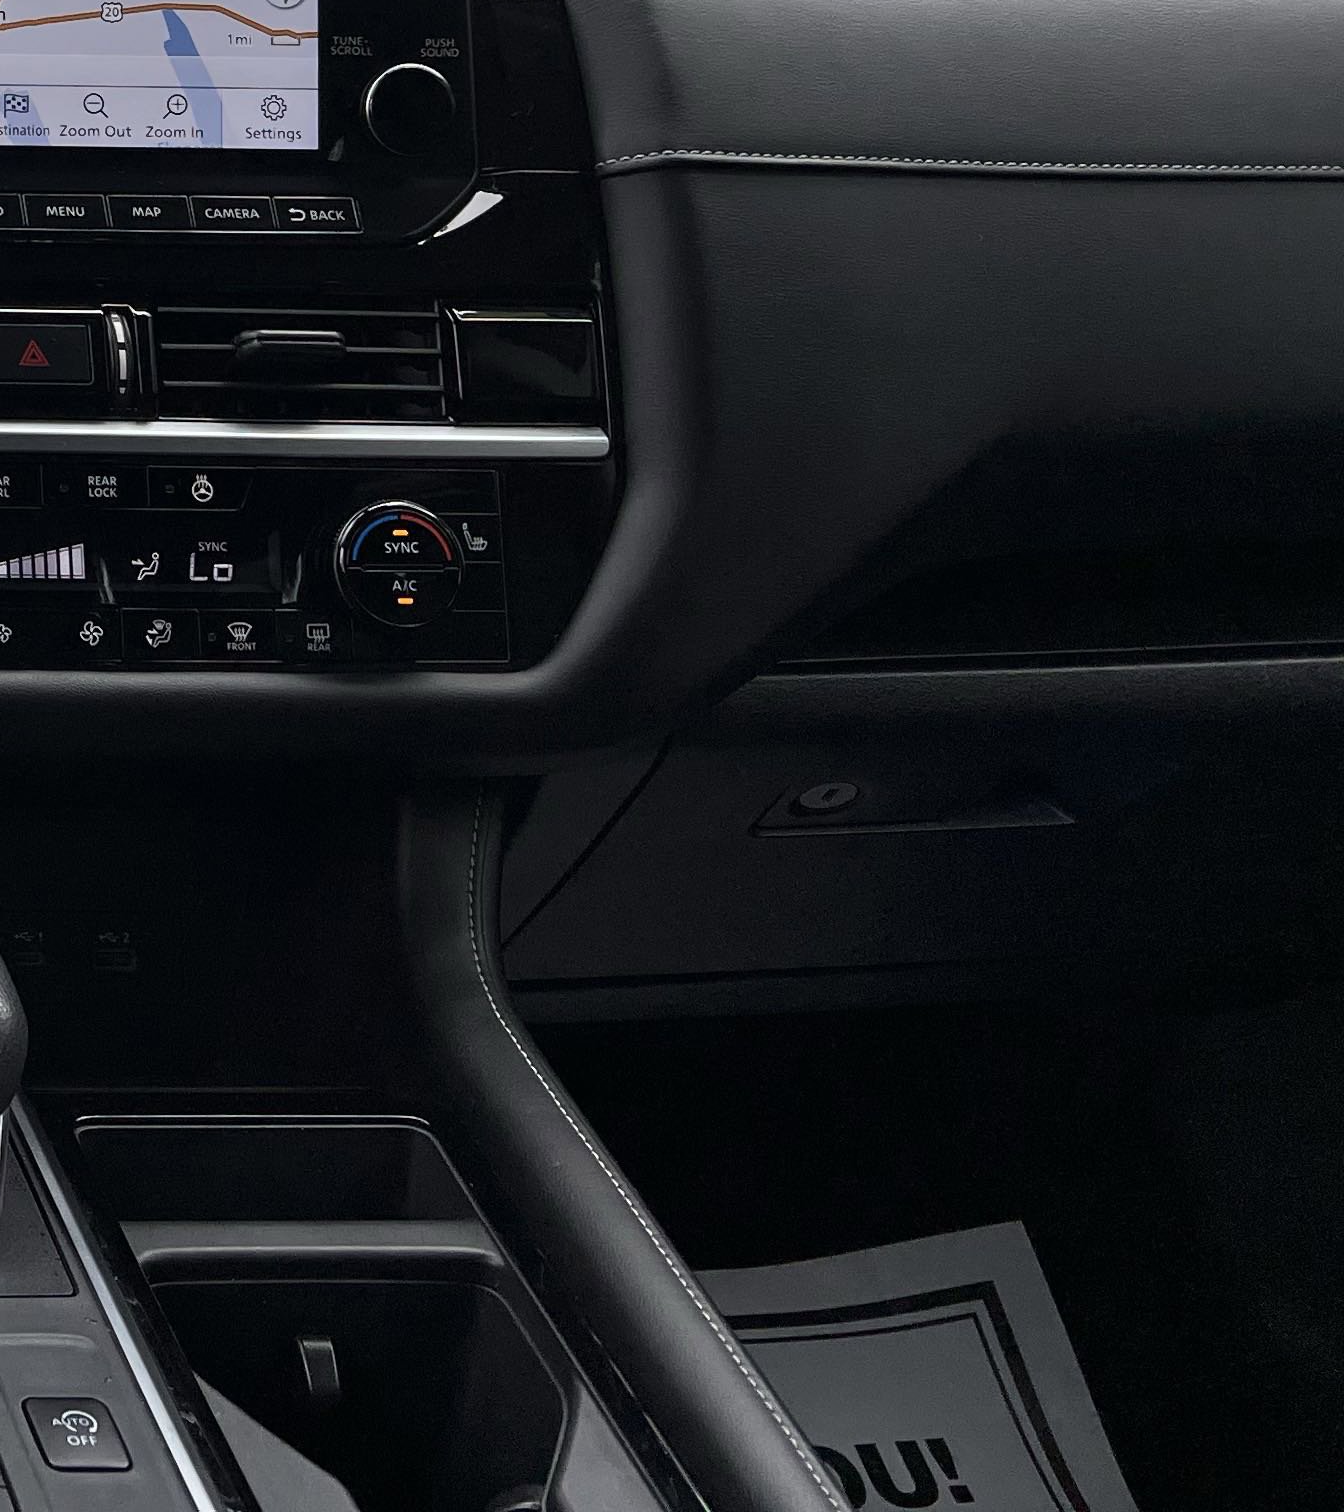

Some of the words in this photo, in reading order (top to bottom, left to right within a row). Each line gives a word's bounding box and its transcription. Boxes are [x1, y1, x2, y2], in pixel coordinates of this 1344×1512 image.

[104, 7, 120, 18] 20
[227, 34, 253, 46] 1mi
[425, 38, 455, 48] PUSH
[330, 46, 373, 57] SCROLL
[420, 48, 460, 58] SOUND
[59, 125, 101, 138] Zoom
[104, 125, 132, 138] Out
[145, 126, 186, 139] Zoom
[191, 126, 204, 139] In
[245, 127, 302, 143] Settings
[46, 205, 85, 217] MENU
[132, 206, 162, 218] MAP
[204, 207, 260, 219] CAMERA
[310, 209, 346, 221] BACK
[87, 476, 118, 487] REAR
[88, 487, 118, 498] LOCK
[197, 541, 229, 553] SYNC
[384, 541, 420, 554] SYNC
[391, 579, 418, 592] A/C
[227, 641, 257, 651] FRONT
[306, 642, 332, 652] REAR
[66, 1435, 98, 1446] OFF
